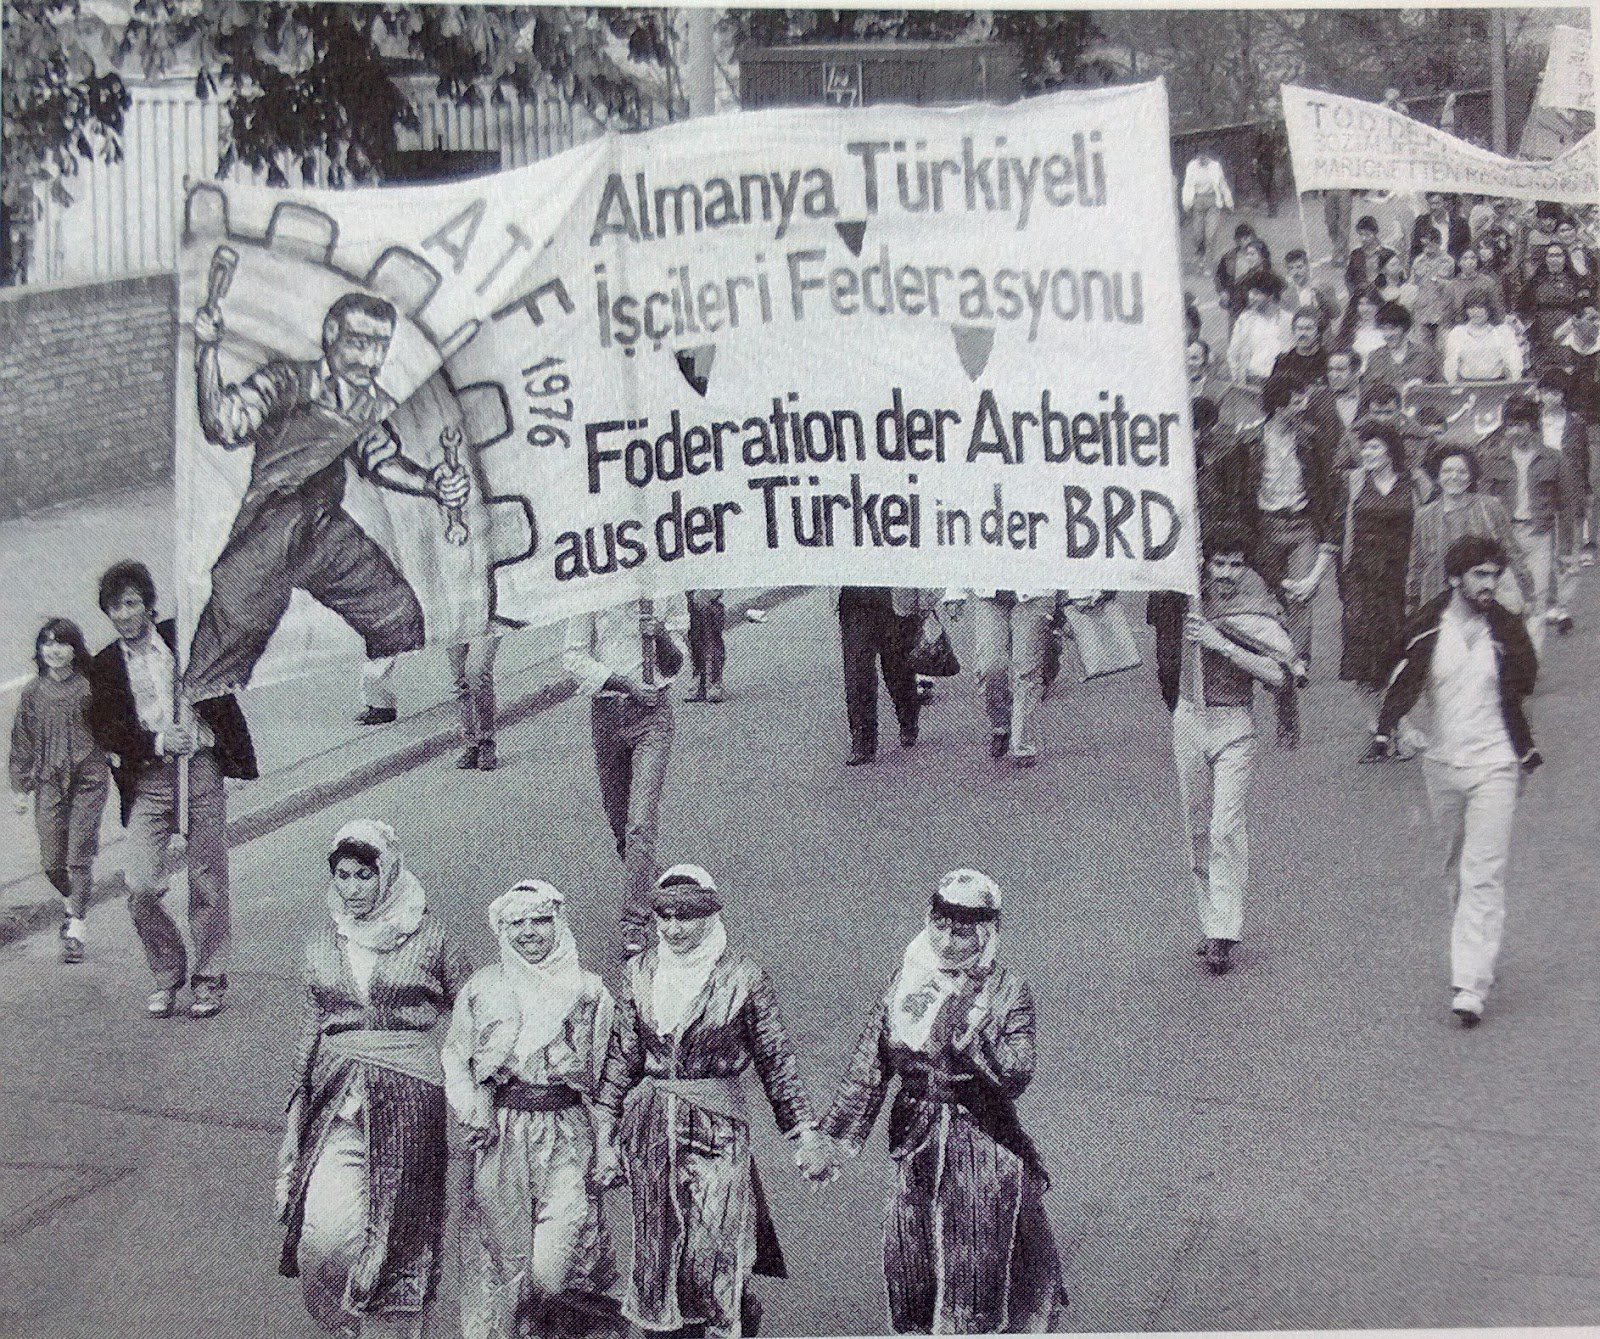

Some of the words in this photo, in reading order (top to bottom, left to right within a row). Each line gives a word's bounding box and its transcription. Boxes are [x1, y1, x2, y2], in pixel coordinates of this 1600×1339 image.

[589, 166, 838, 248] Almanya
[847, 130, 1107, 232] Türkiyeli
[595, 255, 774, 358] İşçileri
[787, 246, 1146, 342] Federasyonu
[521, 355, 574, 449] 1976
[585, 390, 867, 495] Föderation
[876, 387, 963, 464] der
[966, 388, 1180, 467] Arbeiter
[553, 520, 648, 583] aus
[655, 490, 742, 562] der
[747, 473, 920, 550] Türkei
[937, 499, 971, 547] in
[979, 484, 1049, 551] der
[1065, 485, 1182, 562] BRD
